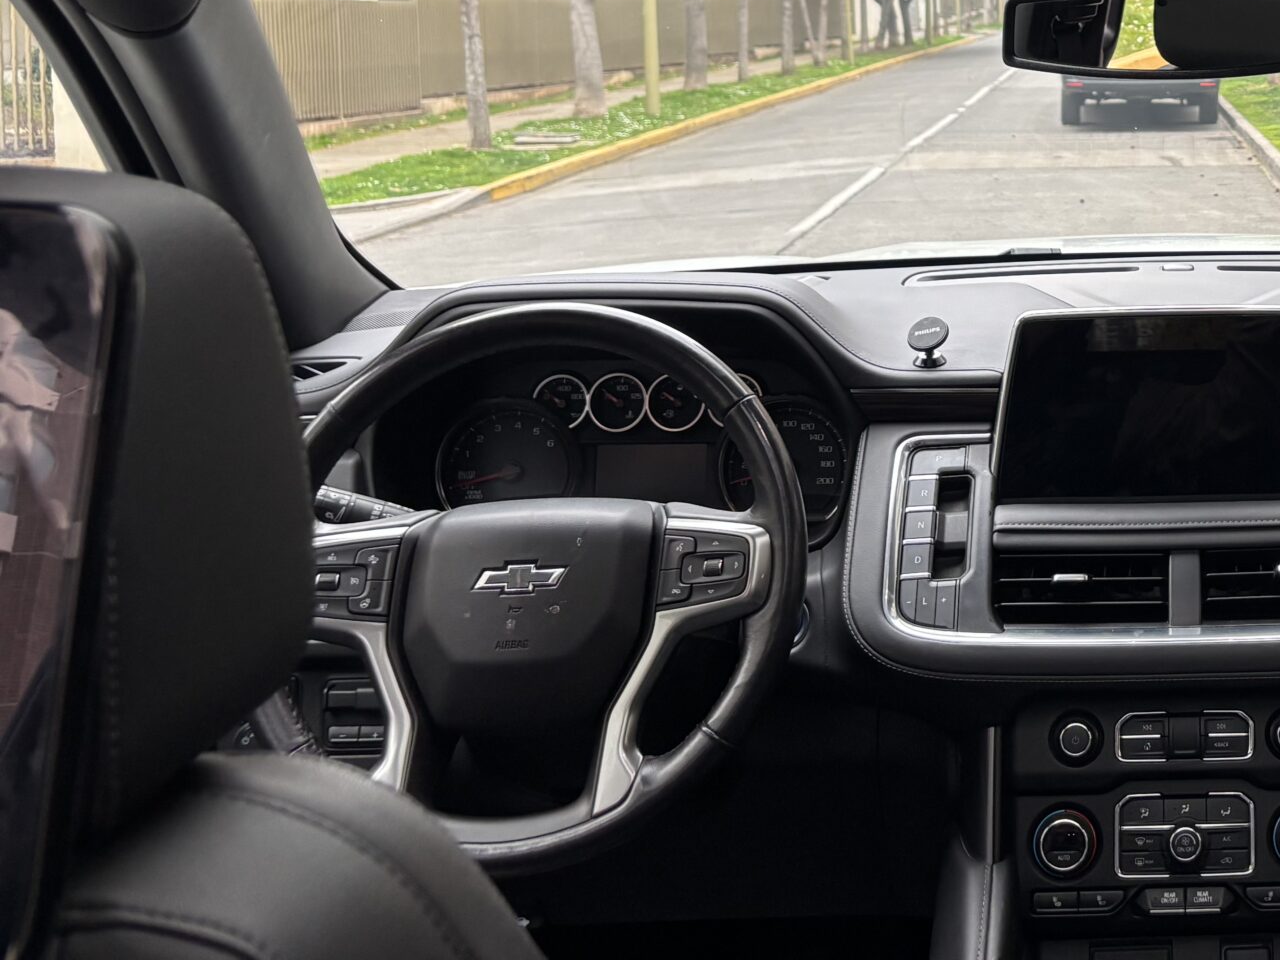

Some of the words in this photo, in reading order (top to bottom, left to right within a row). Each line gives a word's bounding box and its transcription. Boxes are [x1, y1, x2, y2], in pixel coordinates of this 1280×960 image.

[914, 326, 940, 336] PHILIPS
[494, 424, 502, 432] 3
[514, 422, 522, 430] 4
[782, 420, 798, 428] 100
[533, 428, 541, 436] 5
[476, 435, 485, 443] 2
[809, 433, 824, 441] 140
[547, 440, 555, 448] 6
[820, 460, 835, 468] 180
[815, 477, 834, 485] 200
[920, 489, 929, 497] R
[917, 521, 925, 529] N
[914, 556, 921, 564] D
[922, 597, 928, 605] L
[495, 639, 529, 650] AIRBAG
